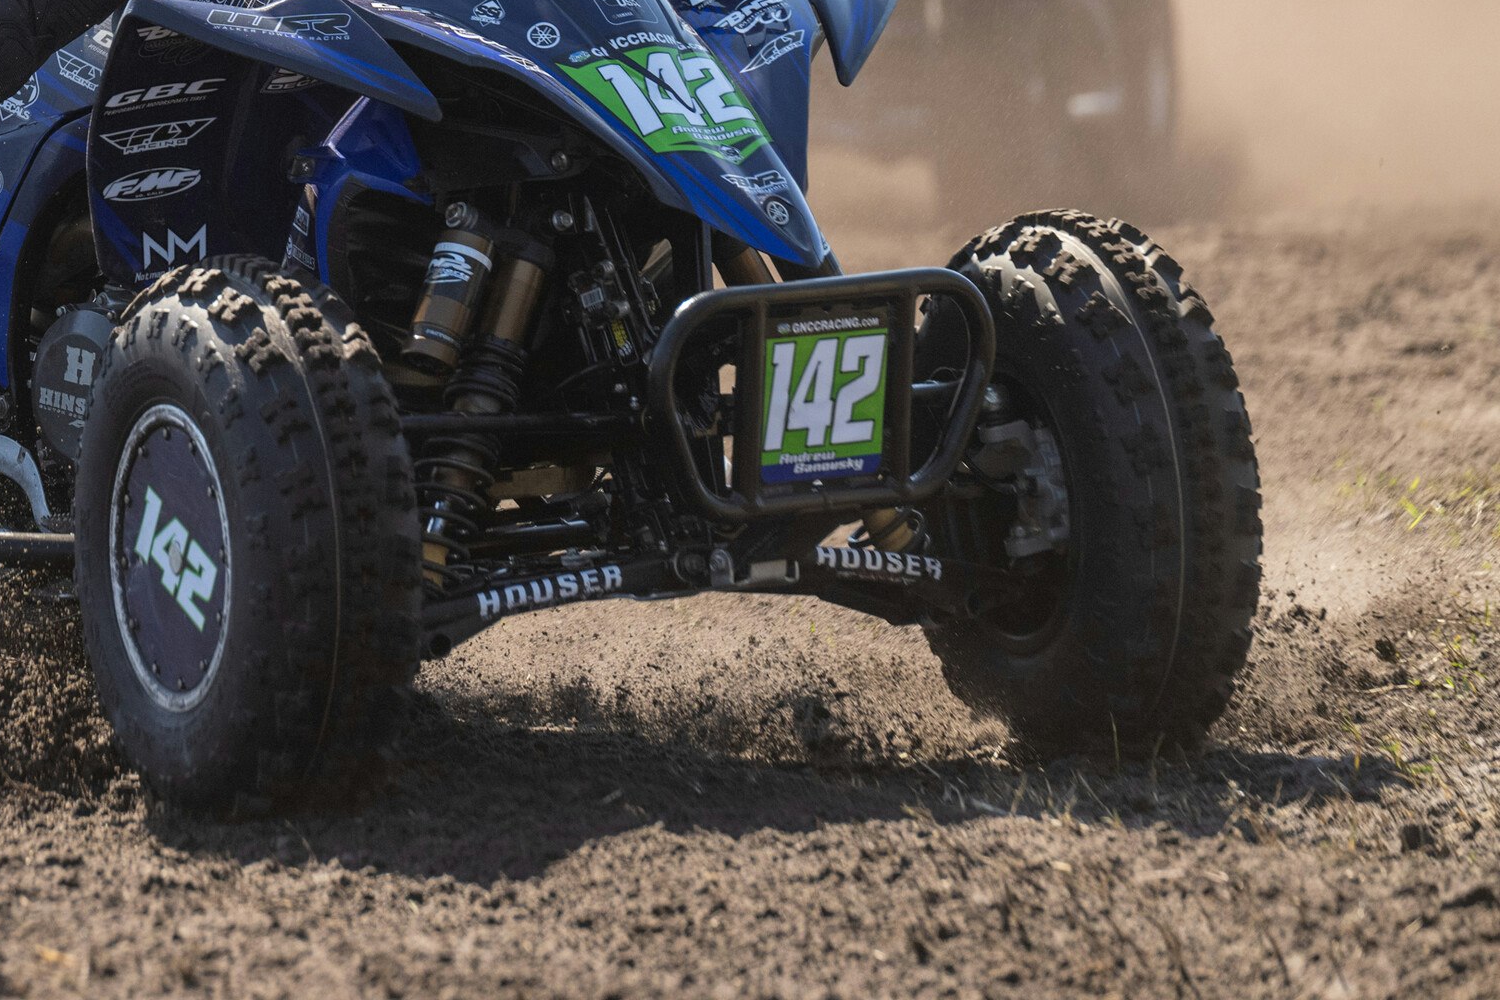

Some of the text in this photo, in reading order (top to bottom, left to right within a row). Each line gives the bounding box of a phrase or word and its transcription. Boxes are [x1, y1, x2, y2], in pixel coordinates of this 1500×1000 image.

[213, 24, 258, 34] WALKER
[309, 34, 350, 42] RACING
[105, 78, 227, 108] GBC
[597, 51, 757, 137] 142
[124, 138, 188, 155] RACING
[103, 169, 202, 199] FMF
[64, 345, 96, 386] H
[764, 335, 886, 451] 142
[134, 485, 218, 633] 142
[815, 546, 945, 581] HOUSER
[476, 564, 624, 619] HOUSER
